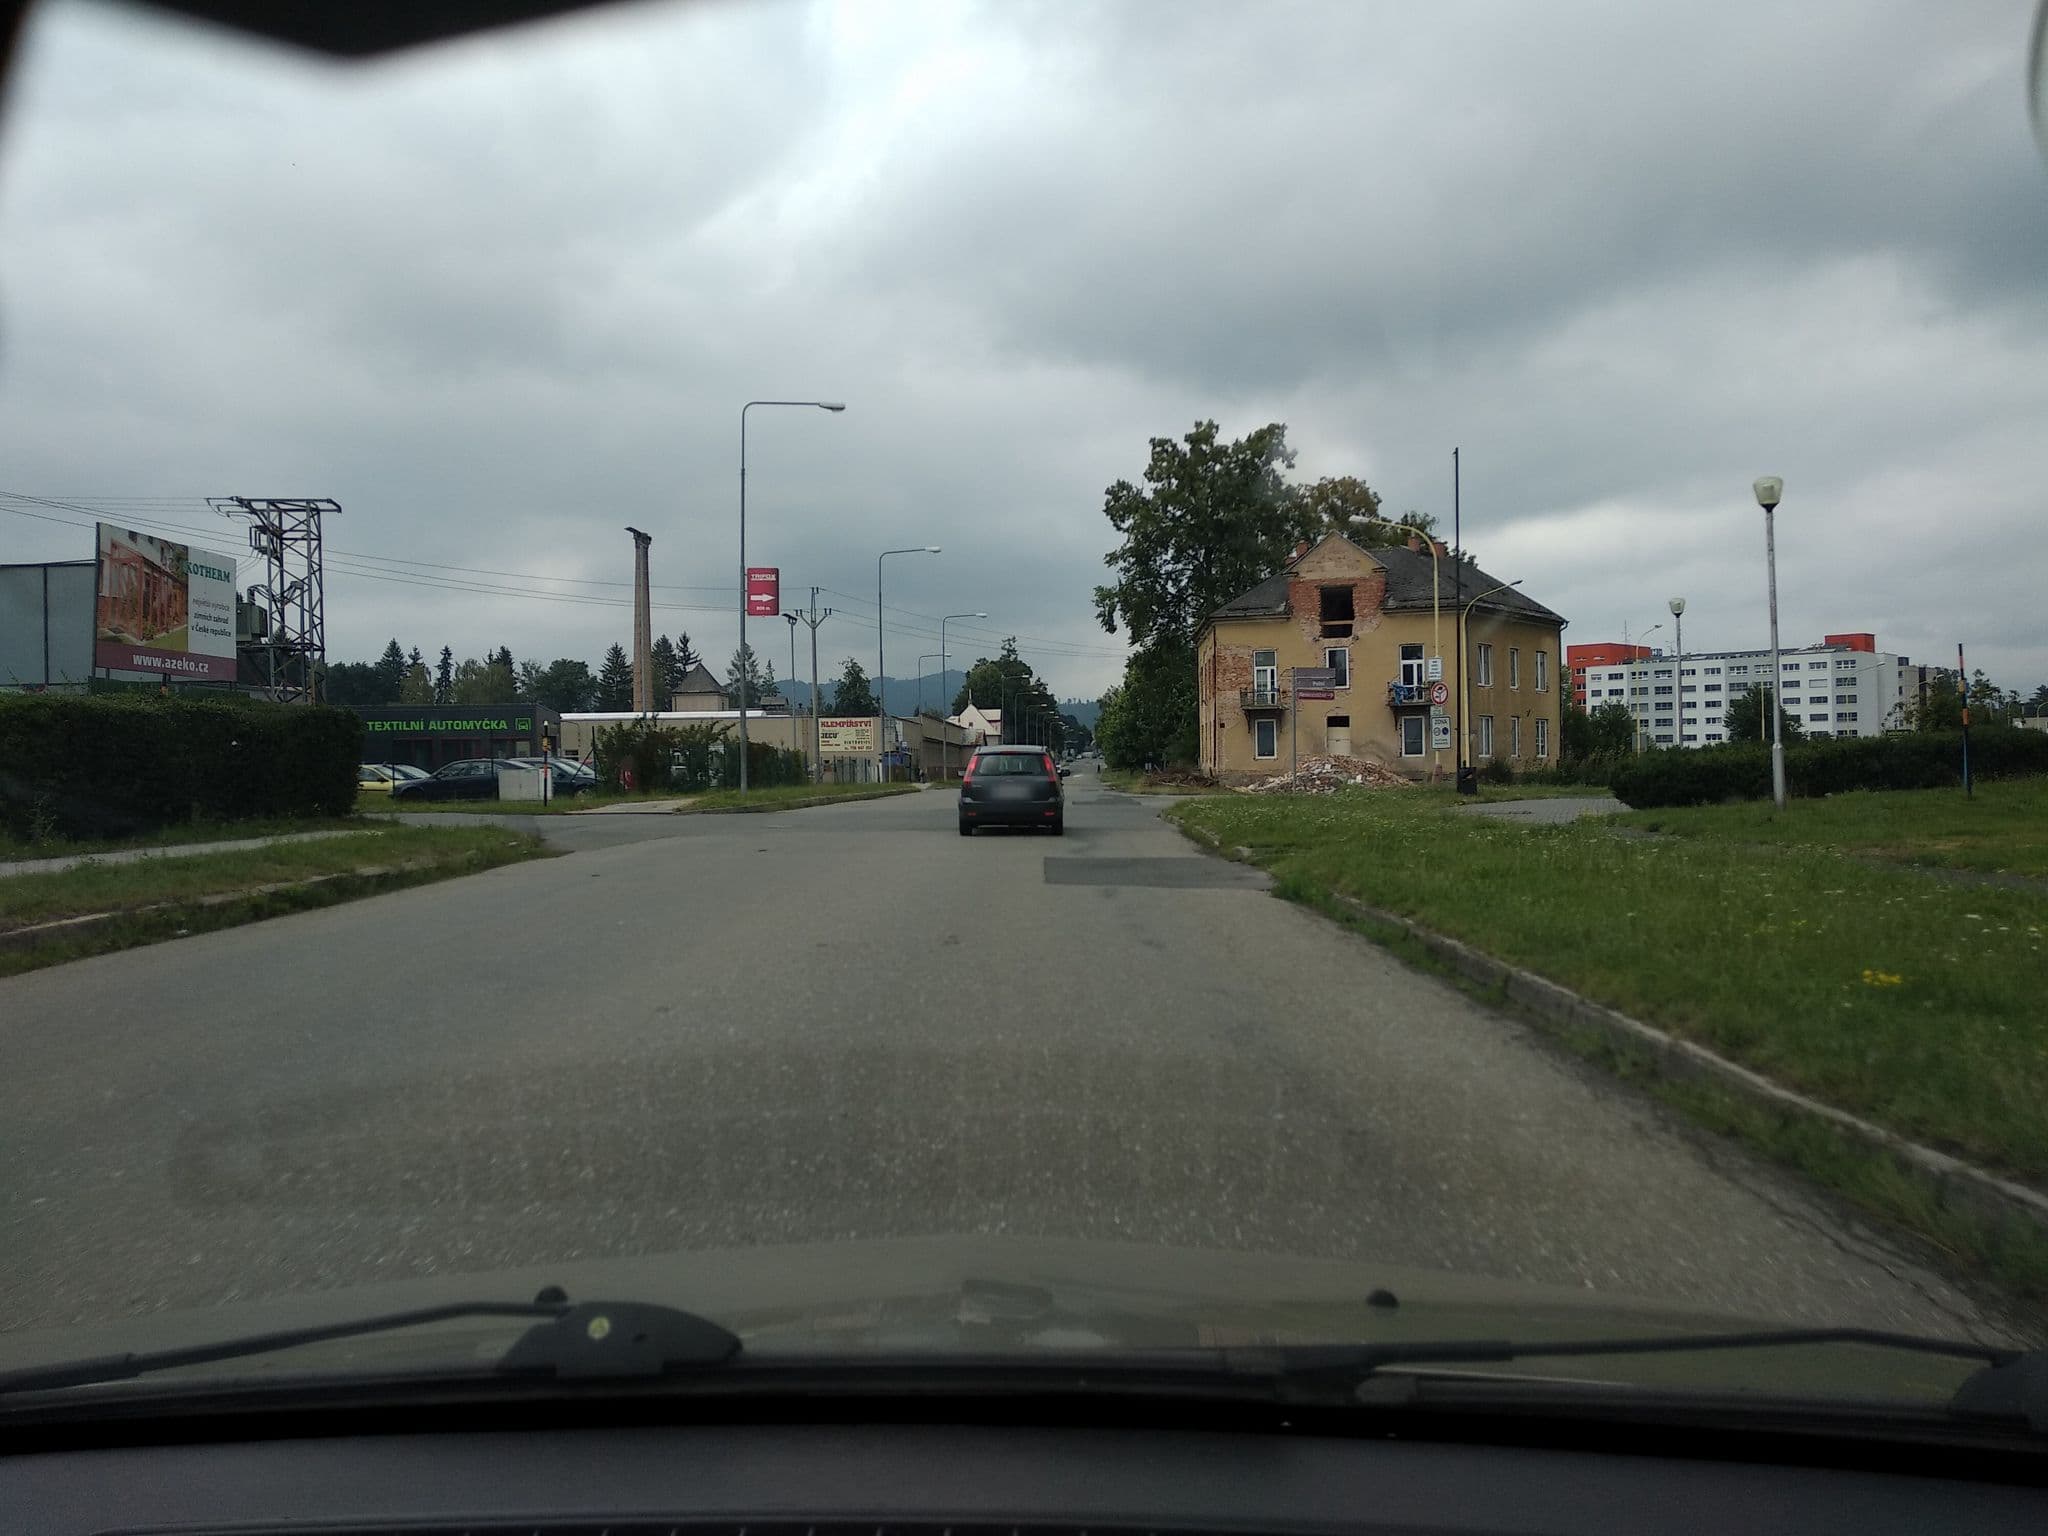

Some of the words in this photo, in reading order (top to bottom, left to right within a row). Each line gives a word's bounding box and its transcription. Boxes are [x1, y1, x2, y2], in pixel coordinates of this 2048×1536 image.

[133, 655, 209, 673] www.azeko.cz
[366, 718, 425, 731] TEXTILNÍ
[428, 717, 508, 730] AUTOMYČKA
